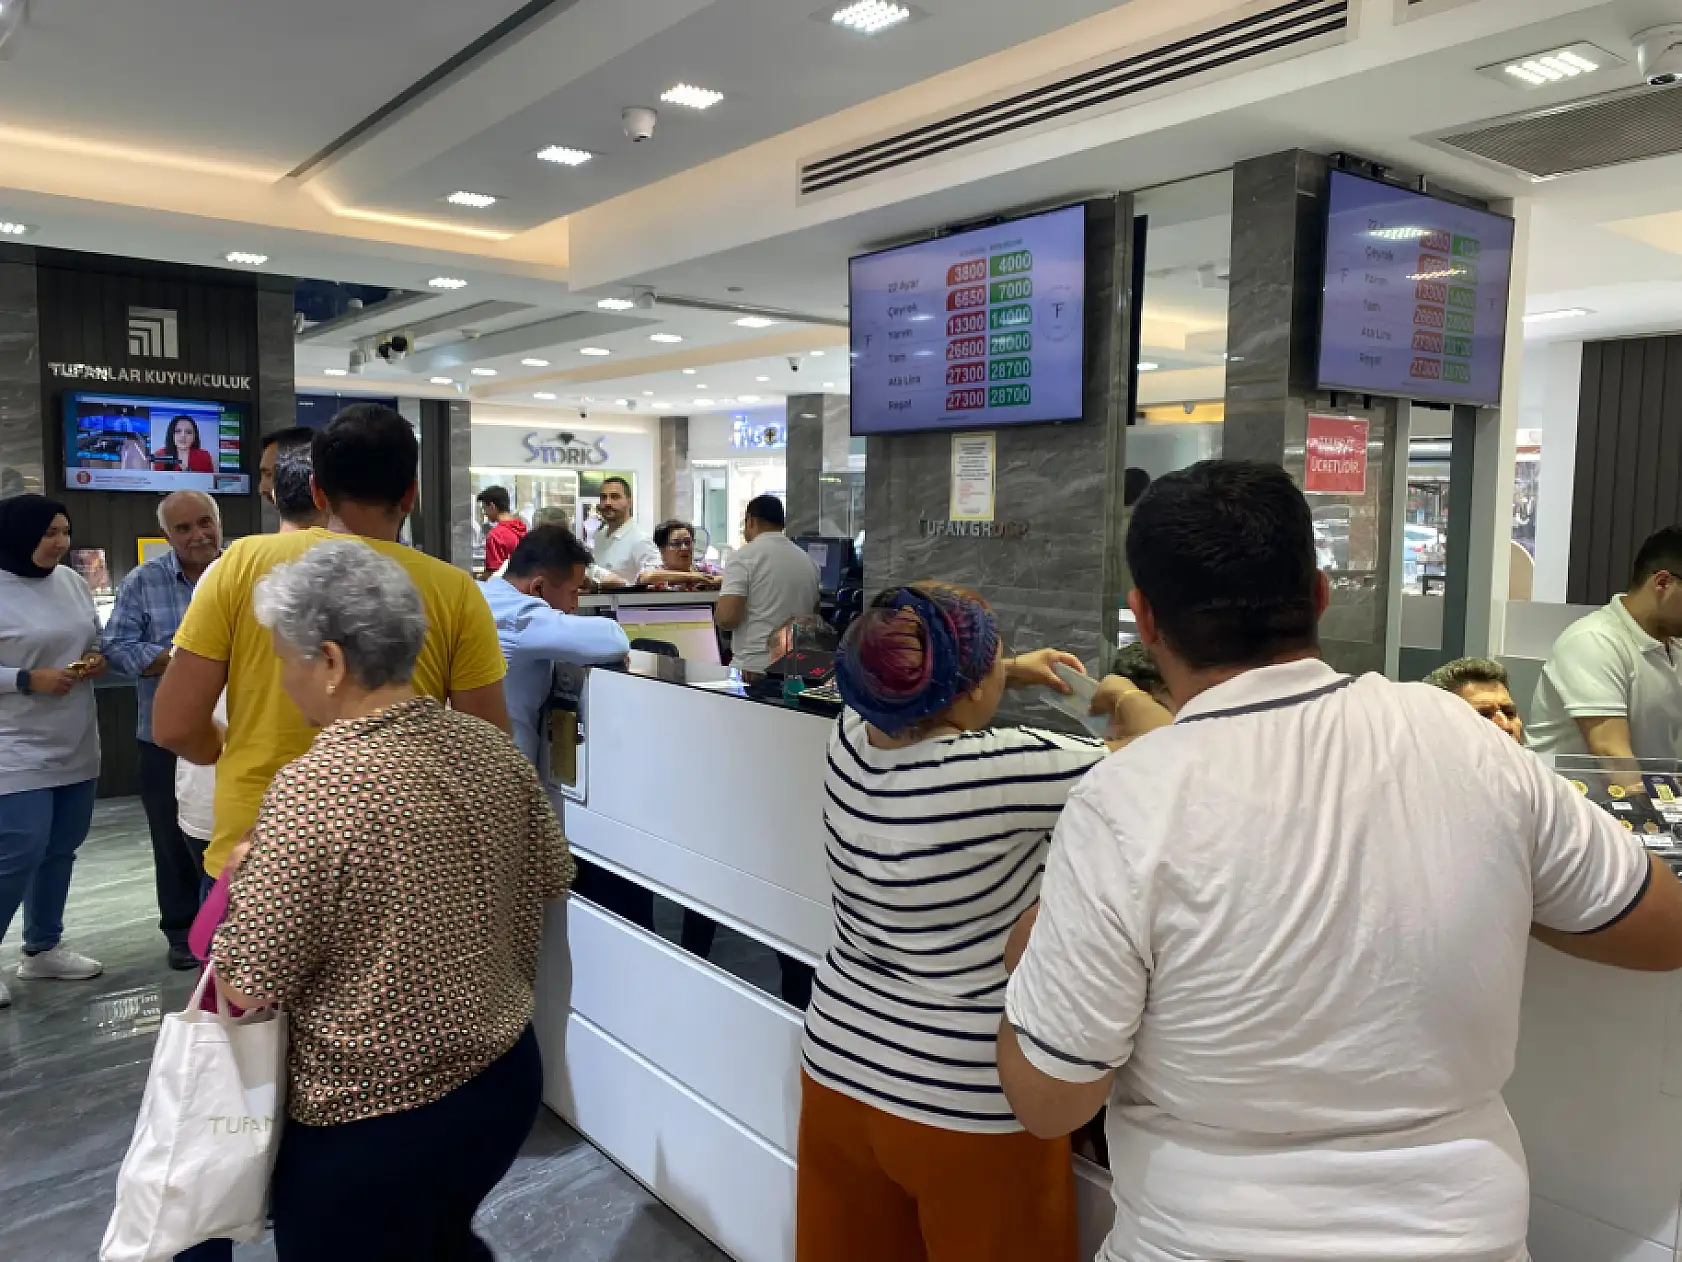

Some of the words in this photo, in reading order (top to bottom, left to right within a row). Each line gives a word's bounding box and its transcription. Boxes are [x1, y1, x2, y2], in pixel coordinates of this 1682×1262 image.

[999, 251, 1032, 272] 4000
[999, 278, 1032, 301] 7000
[948, 339, 984, 359] 26600
[48, 362, 141, 385] TUFANLAR
[144, 369, 252, 391] KUYUMCULUK
[947, 365, 984, 385] 27300
[991, 359, 1031, 380] 28700
[947, 390, 984, 410] 27300
[991, 385, 1031, 405] 28700
[522, 432, 610, 466] STORKS
[918, 518, 966, 538] TUFAN
